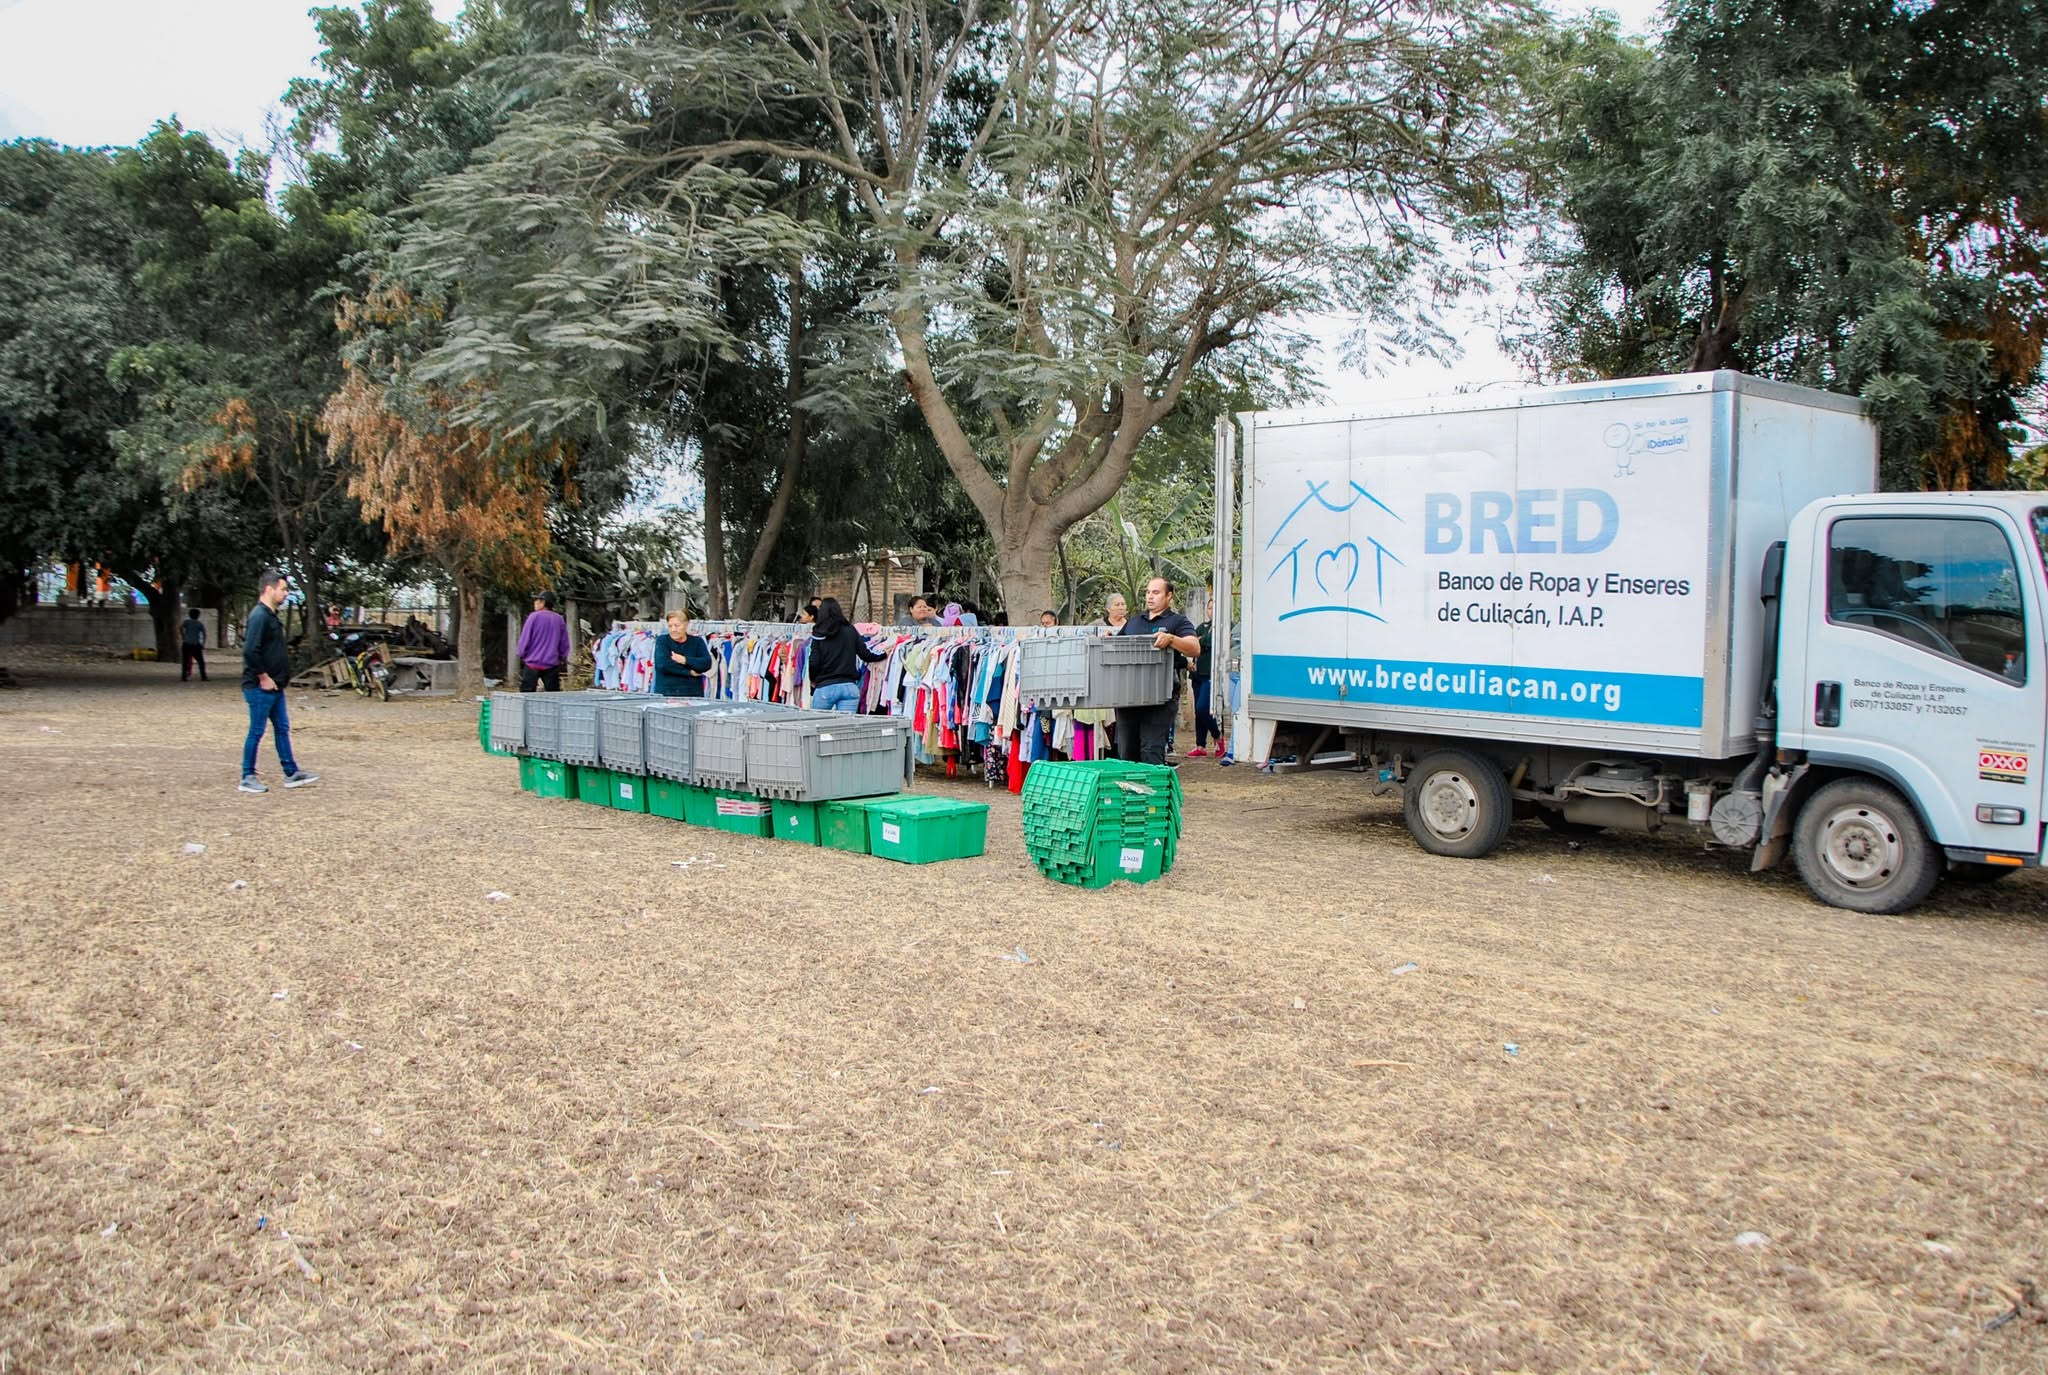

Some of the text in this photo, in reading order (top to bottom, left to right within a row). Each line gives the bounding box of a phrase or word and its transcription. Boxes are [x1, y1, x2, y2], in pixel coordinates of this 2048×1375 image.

[1424, 488, 1620, 555] BRED
[1438, 571, 1690, 597] Banco de Ropa y Enseres
[1438, 602, 1604, 628] de Culiacán, I.A.P.
[1307, 663, 1622, 712] www.bredculiacan.org
[1854, 679, 1966, 694] Banco de Ropa y Enseres
[1871, 690, 1882, 698] de
[1850, 699, 1968, 716] (667)7133057 y 7132057
[1980, 754, 2027, 771] OXXO
